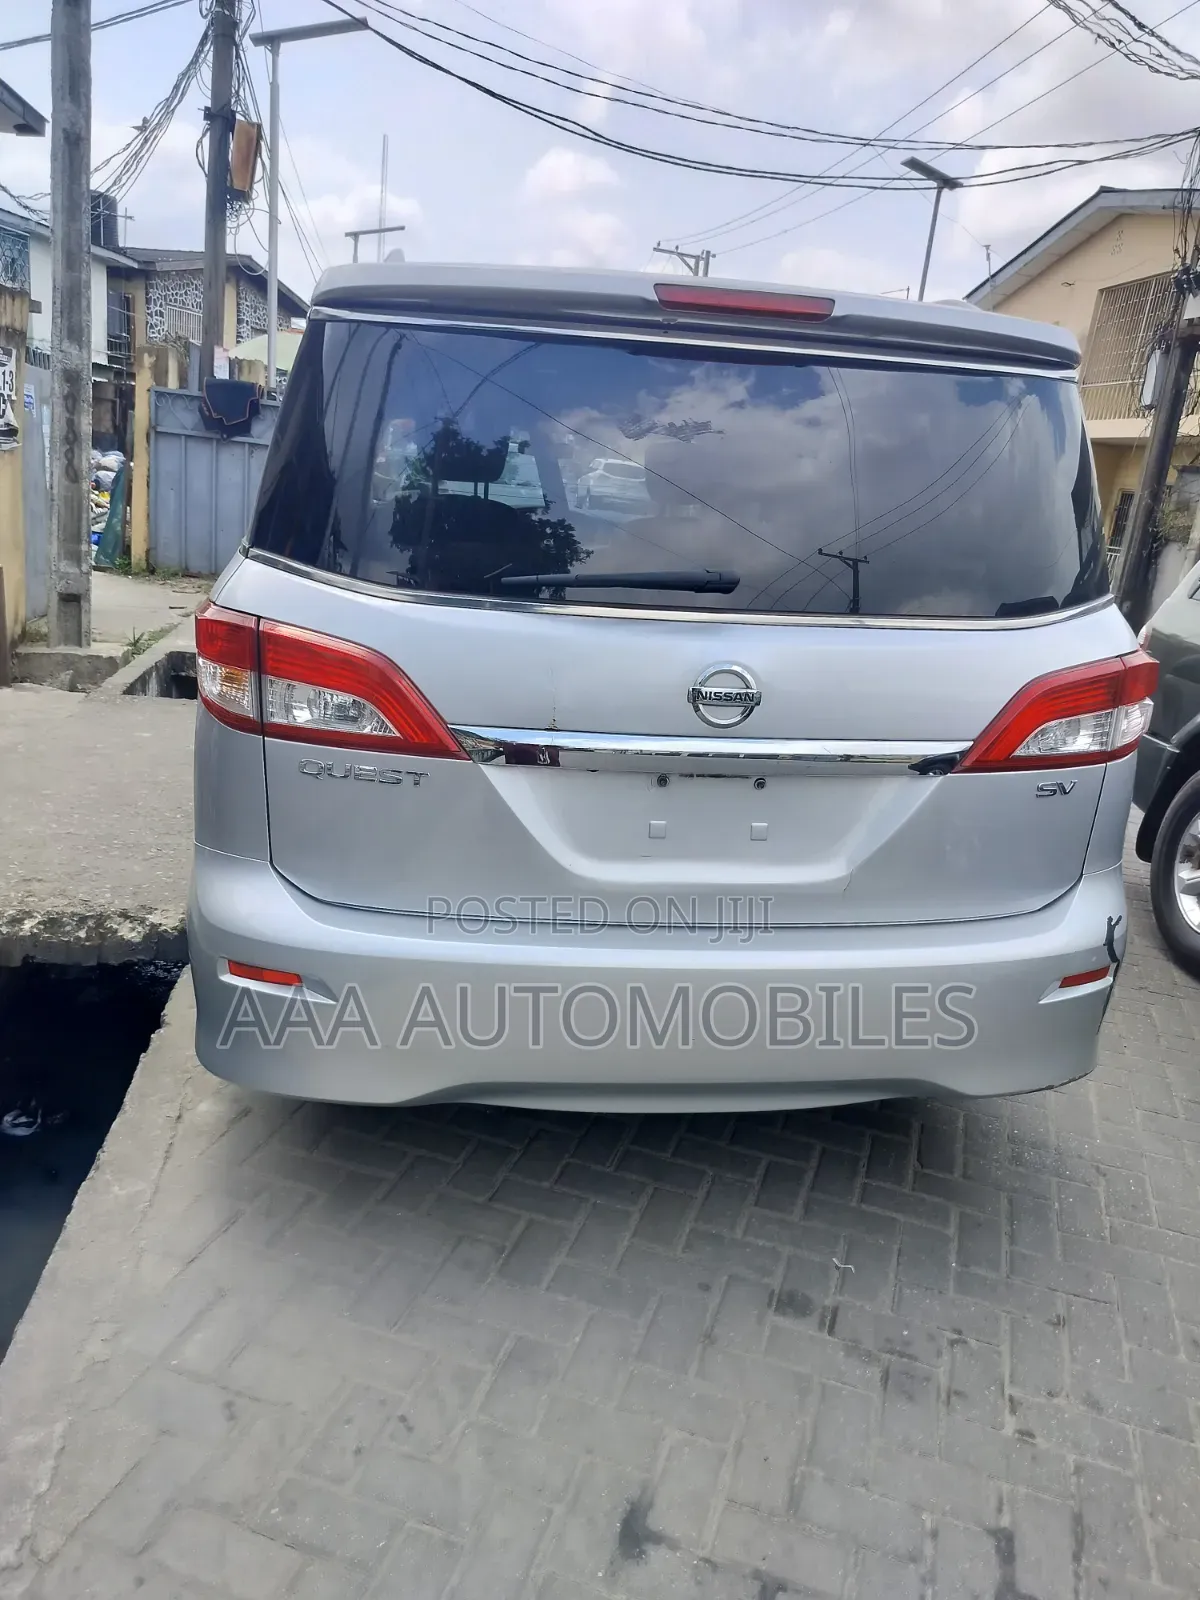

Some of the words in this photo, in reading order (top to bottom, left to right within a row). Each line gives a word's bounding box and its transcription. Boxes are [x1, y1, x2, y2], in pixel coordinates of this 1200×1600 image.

[696, 690, 755, 702] NISSAN
[299, 758, 430, 787] QUEST
[1036, 780, 1078, 798] SV
